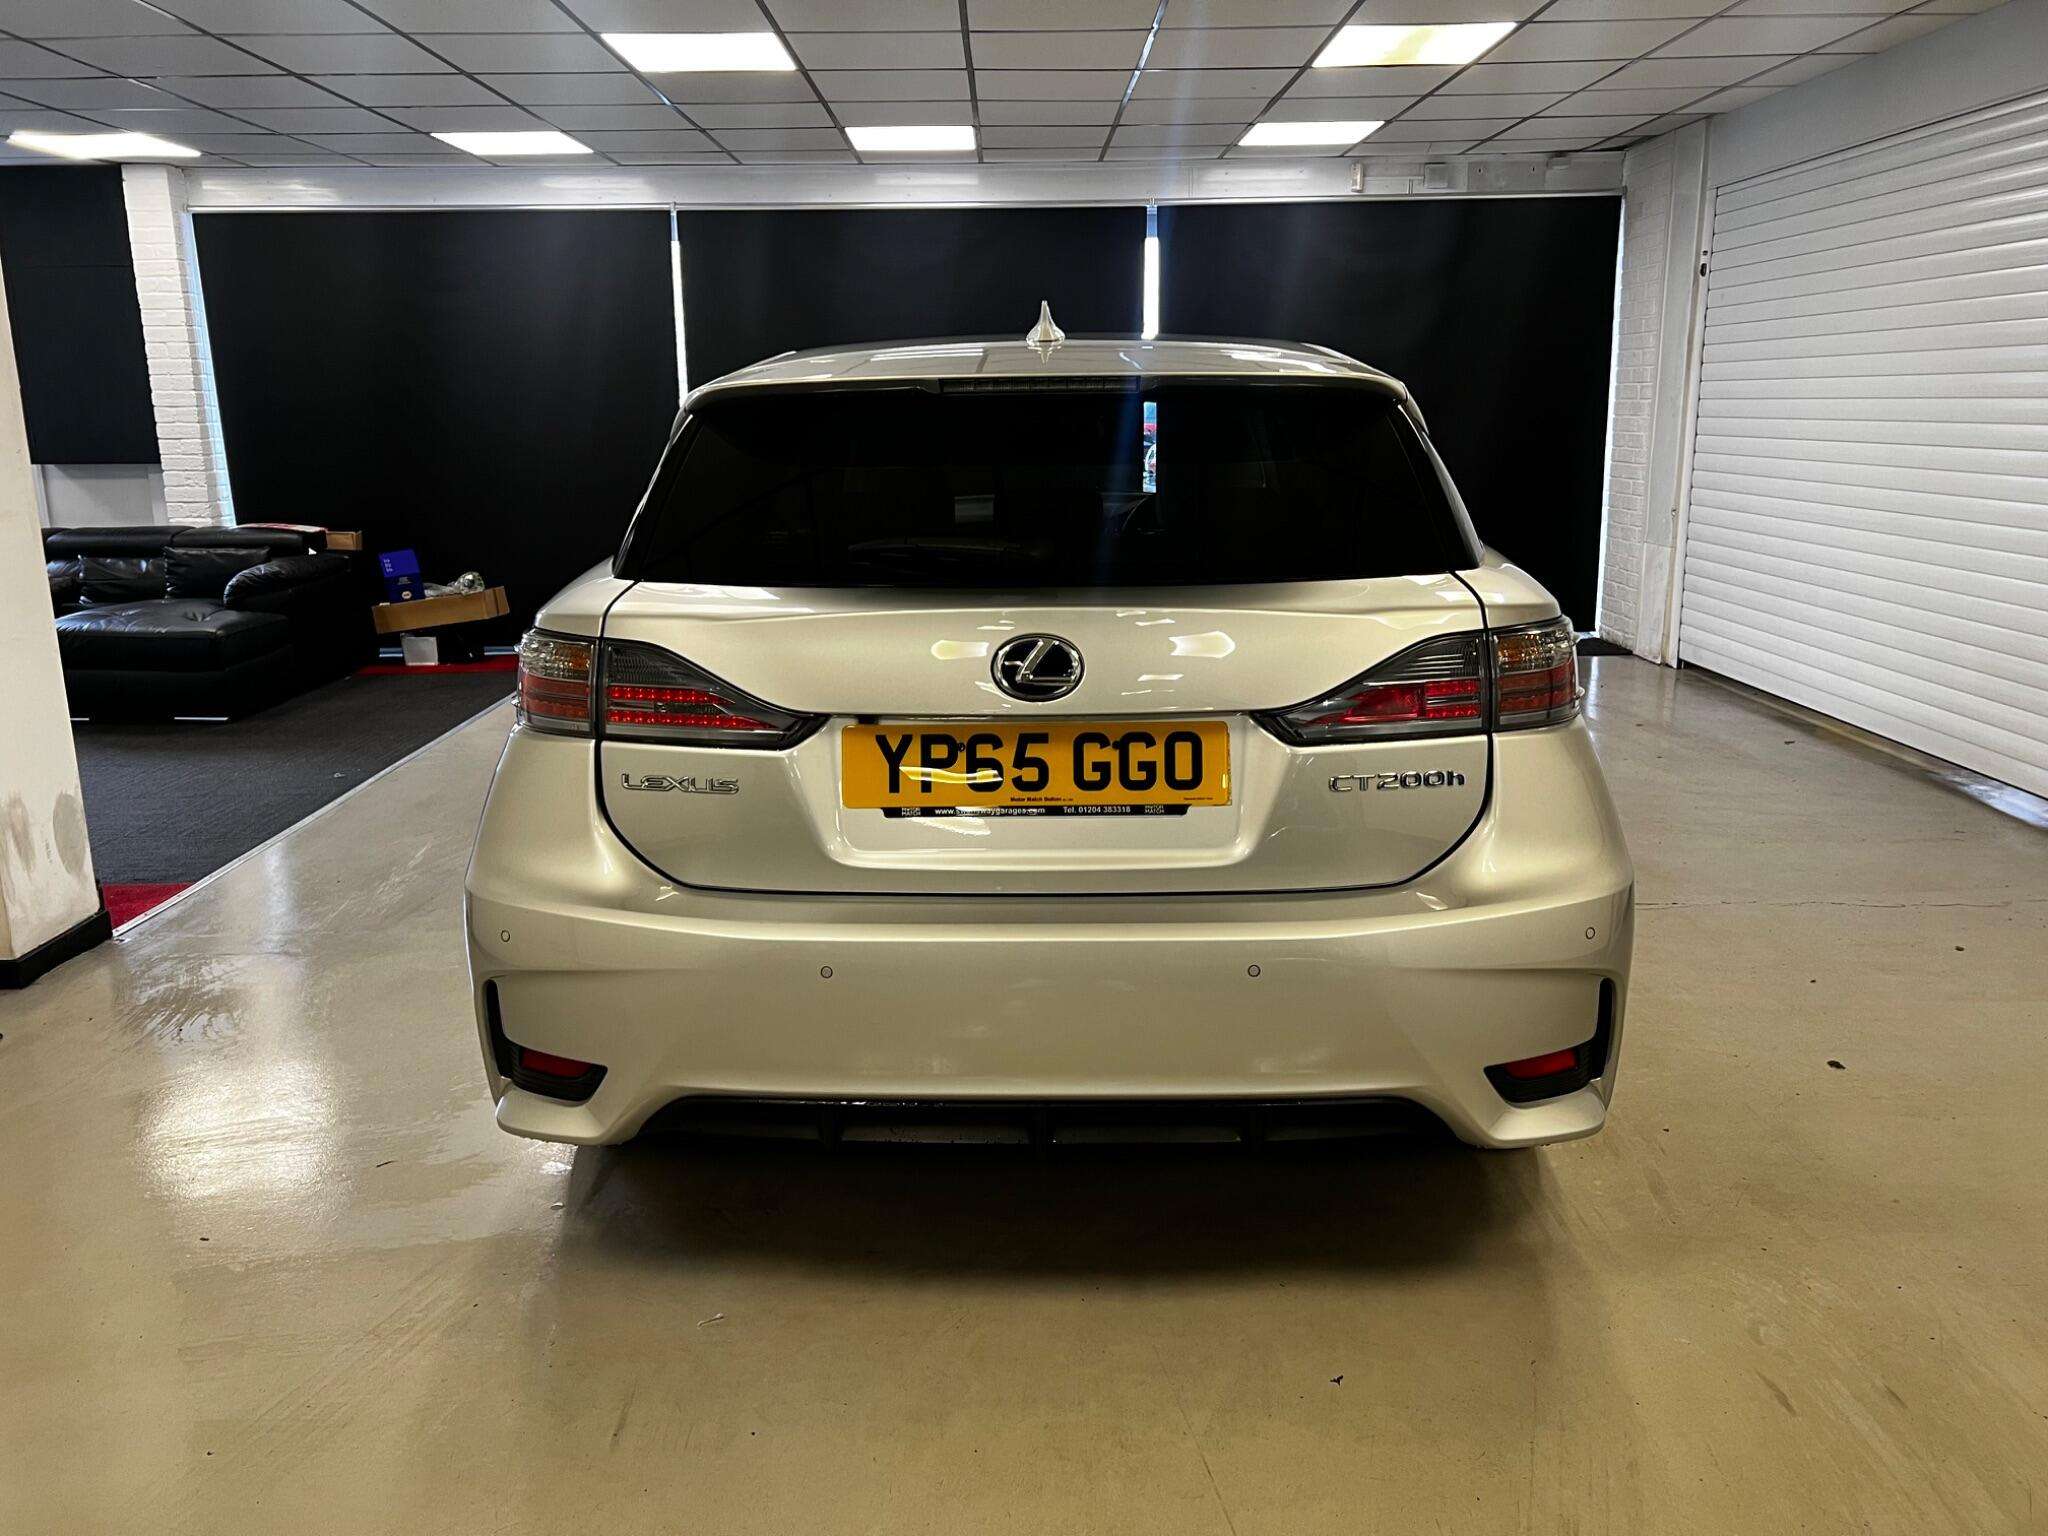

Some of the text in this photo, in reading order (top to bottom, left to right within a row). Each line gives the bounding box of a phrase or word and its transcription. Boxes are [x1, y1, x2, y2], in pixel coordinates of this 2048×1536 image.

[875, 731, 1203, 794] YP65 GGO
[621, 773, 739, 794] LEXUS
[1328, 770, 1465, 792] CT200h
[1064, 806, 1077, 814] Tel.
[1079, 806, 1100, 814] 01204
